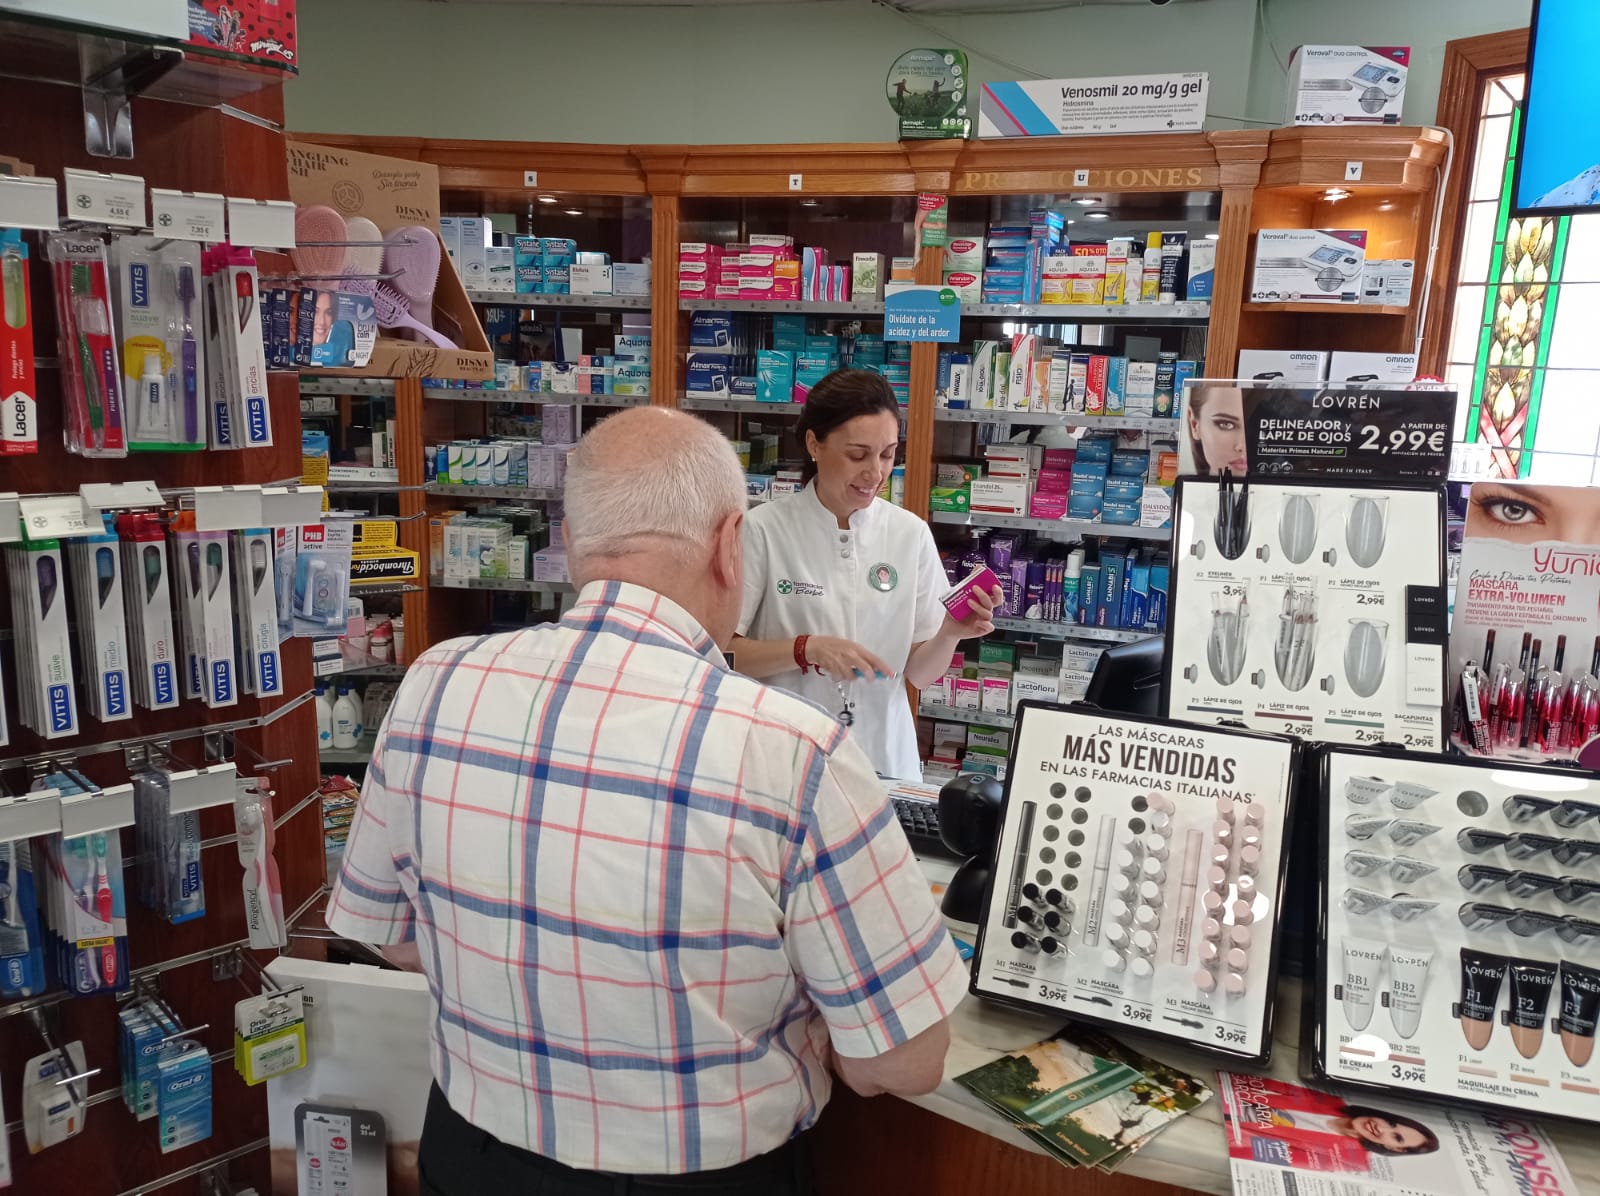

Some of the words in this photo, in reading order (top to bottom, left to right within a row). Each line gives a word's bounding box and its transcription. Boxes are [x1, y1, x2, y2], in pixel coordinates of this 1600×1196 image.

[1061, 85, 1118, 98] Venosmil
[1122, 86, 1138, 96] 20
[1142, 81, 1178, 99] mg/g
[1181, 79, 1202, 97] gel
[292, 158, 326, 171] HAIR
[1077, 174, 1085, 182] U
[395, 205, 430, 218] DISNA
[66, 243, 100, 253] Lacer
[517, 240, 539, 249] Systane
[545, 241, 567, 249] Systane
[1075, 248, 1088, 256] 50
[519, 267, 540, 275] Systane
[545, 267, 567, 276] Systane
[135, 267, 143, 304] VITIS
[889, 314, 916, 325] Olvídate
[919, 316, 926, 325] de
[928, 317, 936, 325] la
[888, 327, 910, 337] acidez
[912, 329, 915, 338] y
[918, 328, 929, 337] del
[930, 328, 950, 337] ardor
[456, 357, 488, 368] DISNA
[1290, 353, 1317, 361] OMRON
[691, 361, 711, 369] Almax
[1312, 393, 1380, 409] LOVRÉN
[14, 396, 26, 437] Lacer
[253, 401, 261, 438] VITIS
[220, 406, 229, 441] VITIS
[1260, 419, 1341, 430] DELINEADOR
[1345, 422, 1351, 433] y
[1259, 427, 1293, 441] LÁPIZ
[1299, 432, 1314, 441] DE
[1318, 431, 1351, 444] OJOS
[1358, 425, 1446, 455] 2,99€
[304, 532, 322, 540] PHB
[359, 561, 414, 574] Thrombocid
[1106, 566, 1116, 602] CANNABIS
[1356, 594, 1384, 605] 2,99€
[1468, 589, 1566, 606] EXTRA-VOLUMEN
[157, 640, 165, 659] duro
[1068, 650, 1098, 658] Lactoflora
[263, 655, 273, 690] VITIS
[159, 666, 167, 701] VITIS
[218, 664, 226, 701] VITIS
[1016, 681, 1056, 693] Lactoflora
[109, 674, 120, 713] VITIS
[54, 688, 66, 728] VITIS
[1394, 714, 1433, 722] SACAPUNTAS
[1284, 723, 1313, 736] 2,99€
[1355, 729, 1384, 743] 2,99€
[1098, 724, 1123, 737] LAS
[1127, 730, 1204, 749] MÁSCARAS
[1404, 734, 1434, 746] 2,99€
[1062, 734, 1112, 764] MÁS
[1120, 742, 1236, 784] VENDIDAS
[1040, 761, 1058, 773] EN
[1063, 764, 1087, 778] LAS
[1091, 768, 1172, 792] FARMACIAS
[1088, 920, 1097, 936] M2
[1176, 938, 1186, 954] M3
[1345, 949, 1382, 961] LOVRÉN
[1076, 978, 1088, 986] M2
[1347, 974, 1368, 986] BB1
[1515, 973, 1553, 985] LOVRÉN
[1038, 984, 1067, 1002] 3,99€
[1393, 981, 1416, 993] BB2
[1166, 998, 1177, 1006] M3
[1466, 988, 1481, 1003] F1
[1517, 997, 1534, 1011] F2
[1564, 1001, 1581, 1017] F3
[1122, 1004, 1152, 1022] 3,99€
[1214, 1026, 1246, 1044] 3,99€
[1350, 1060, 1372, 1069] CREAM
[1459, 1054, 1467, 1062] F1
[1510, 1063, 1520, 1071] F2
[1392, 1065, 1426, 1083] 3,99€
[1458, 1078, 1499, 1091] MAQUILLAJE
[1514, 1088, 1539, 1097] CREMA
